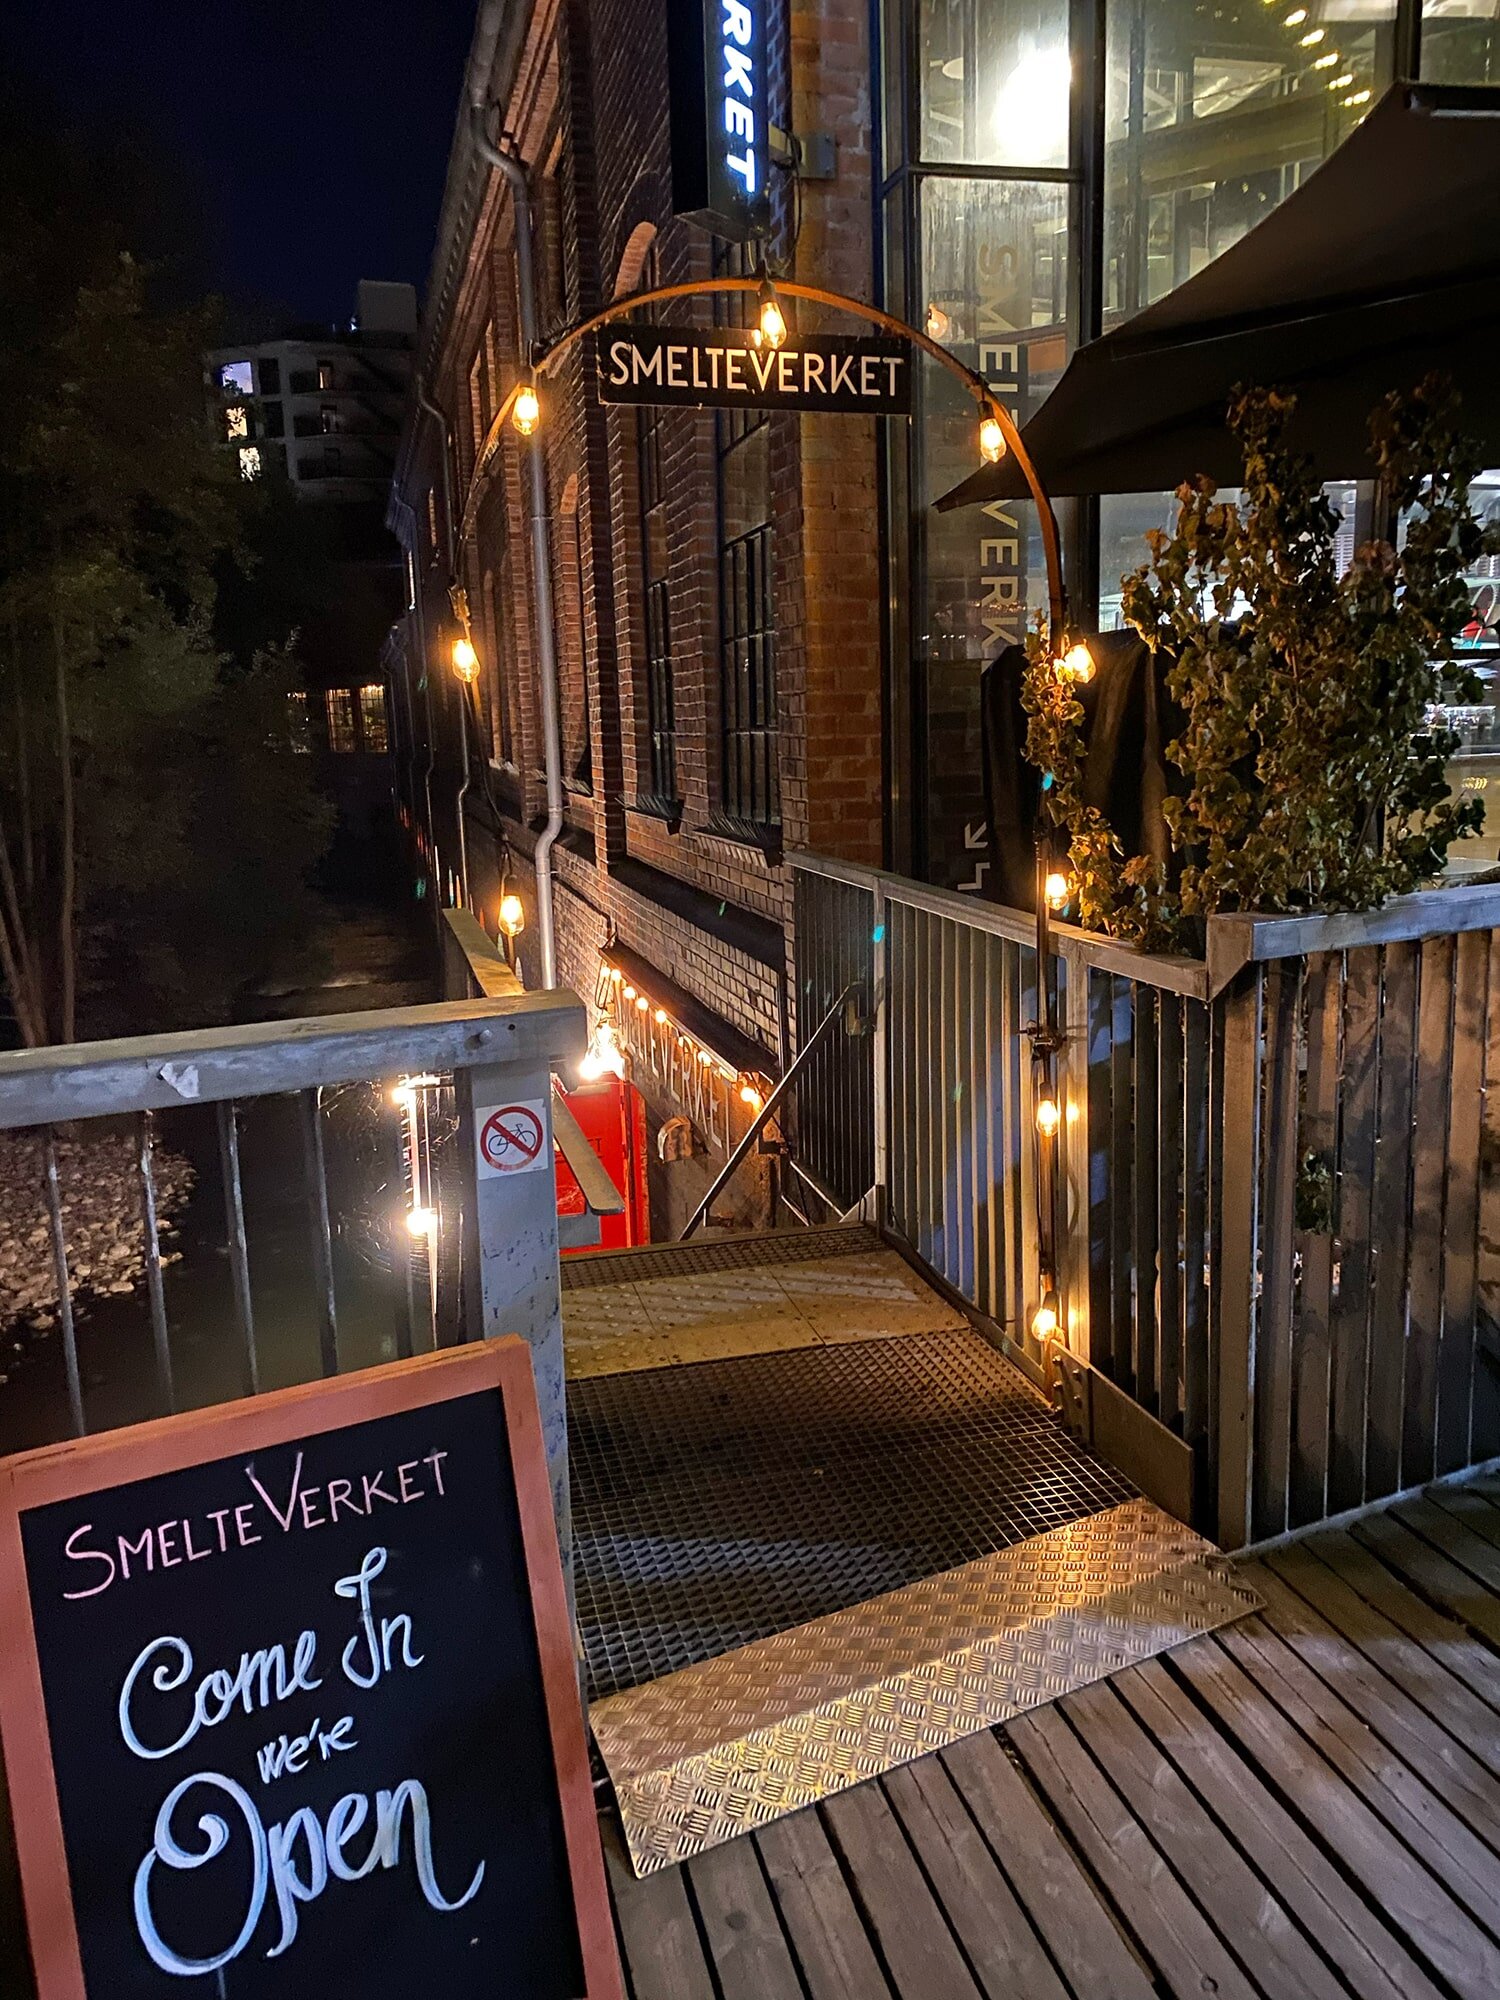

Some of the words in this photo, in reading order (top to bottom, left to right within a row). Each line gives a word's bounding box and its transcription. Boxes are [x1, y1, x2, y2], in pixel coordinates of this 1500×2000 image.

[609, 340, 904, 397] SMELTEVERKET
[118, 1630, 323, 1760] Come
[334, 1546, 425, 1689] In
[133, 1771, 486, 1976] Open
